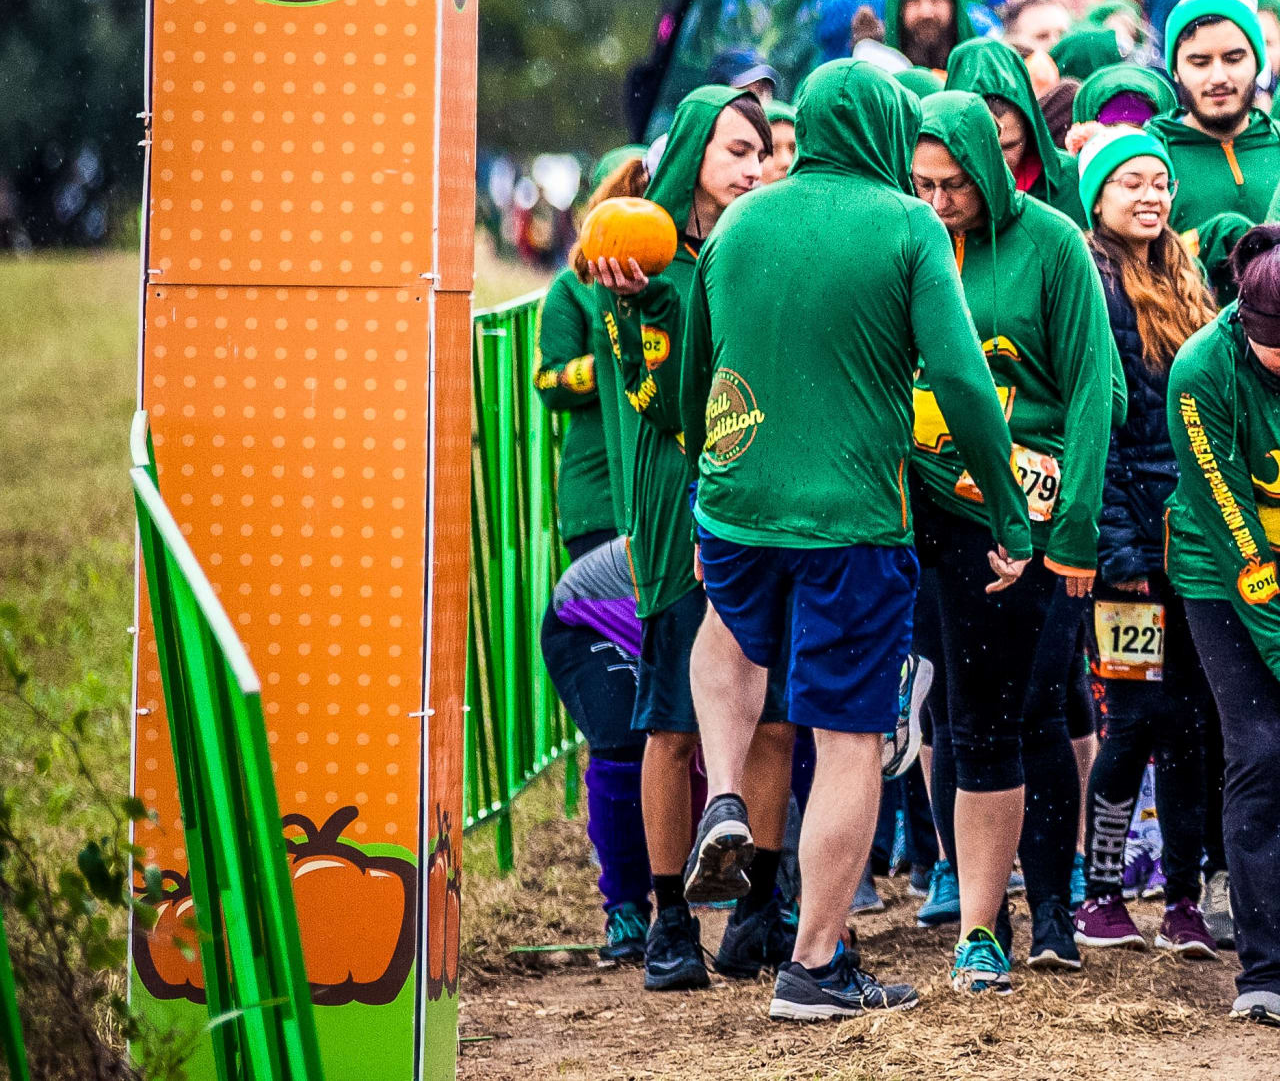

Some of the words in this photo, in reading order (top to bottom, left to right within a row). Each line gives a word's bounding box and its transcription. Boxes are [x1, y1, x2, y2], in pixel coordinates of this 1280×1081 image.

[1180, 397, 1200, 425] THE
[1187, 425, 1217, 479] GREAT
[1208, 470, 1245, 531] PUMPKIN
[1232, 527, 1259, 560] RUN
